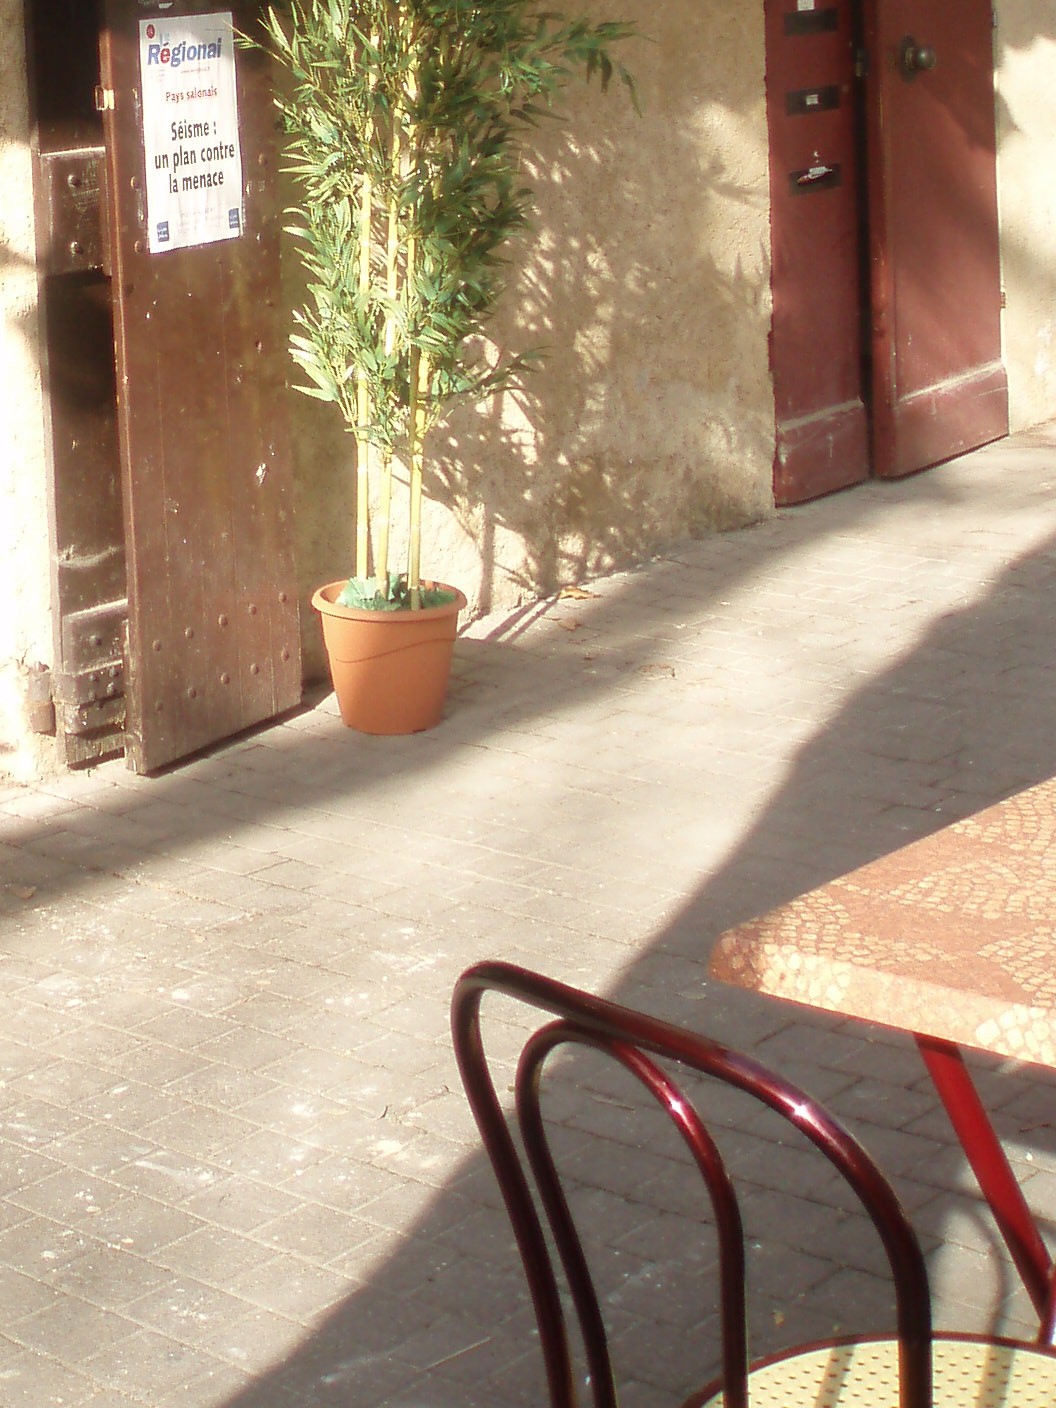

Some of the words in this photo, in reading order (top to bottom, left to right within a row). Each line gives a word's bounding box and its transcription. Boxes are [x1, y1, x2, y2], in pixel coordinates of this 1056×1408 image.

[147, 37, 223, 68] Régional
[165, 91, 185, 103] Pays
[186, 84, 218, 100] salonais
[171, 119, 210, 141] Séisme
[154, 153, 170, 169] un
[173, 145, 197, 174] plan
[200, 141, 235, 163] contre
[169, 173, 179, 194] la
[182, 171, 224, 192] menace
